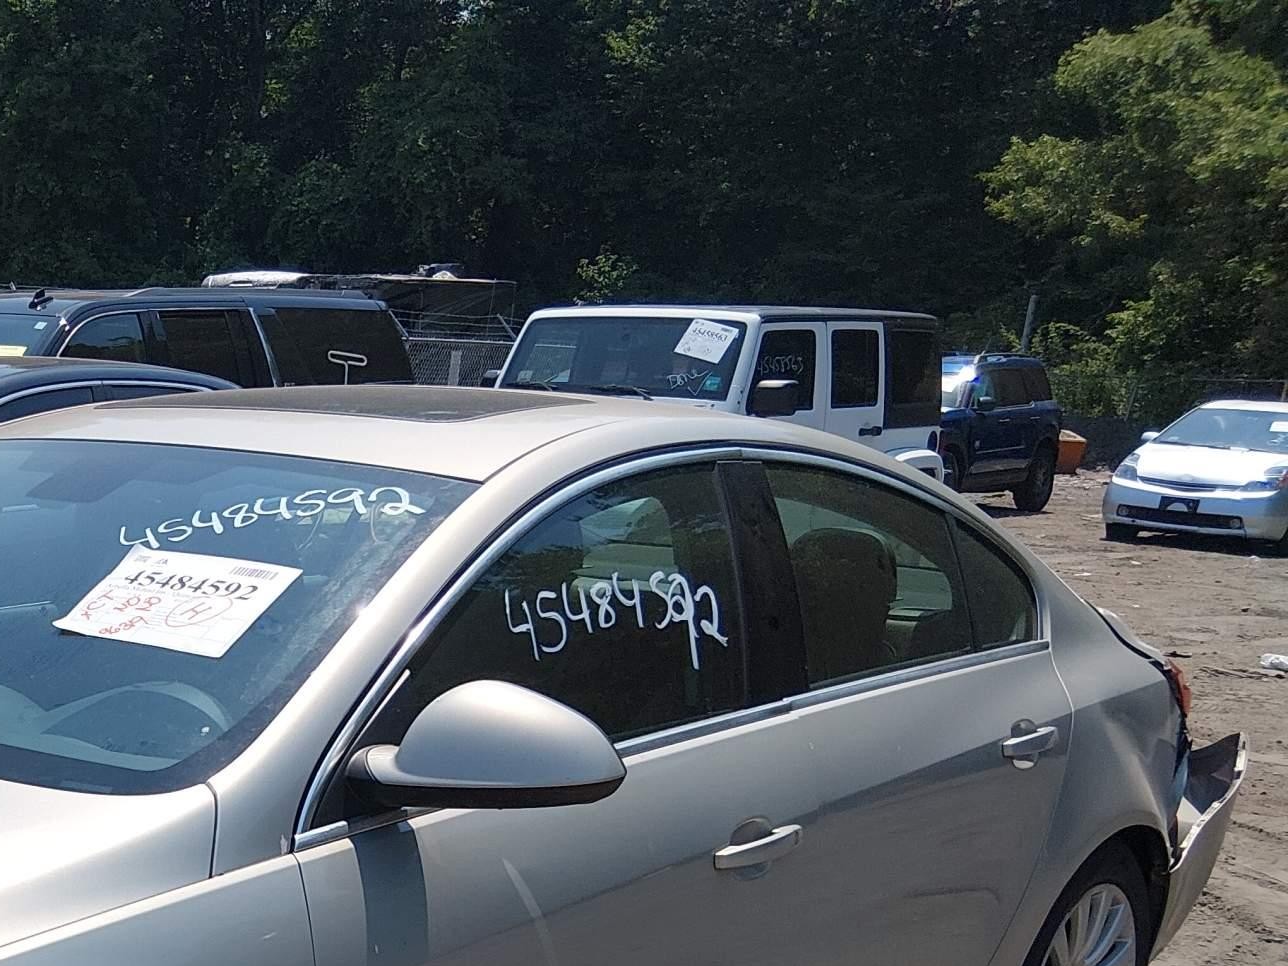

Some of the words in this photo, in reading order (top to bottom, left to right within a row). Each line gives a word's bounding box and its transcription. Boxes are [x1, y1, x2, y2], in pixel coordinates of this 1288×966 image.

[118, 486, 425, 550] 45484592
[124, 570, 259, 601] 45484592
[504, 570, 728, 670] 45484592
